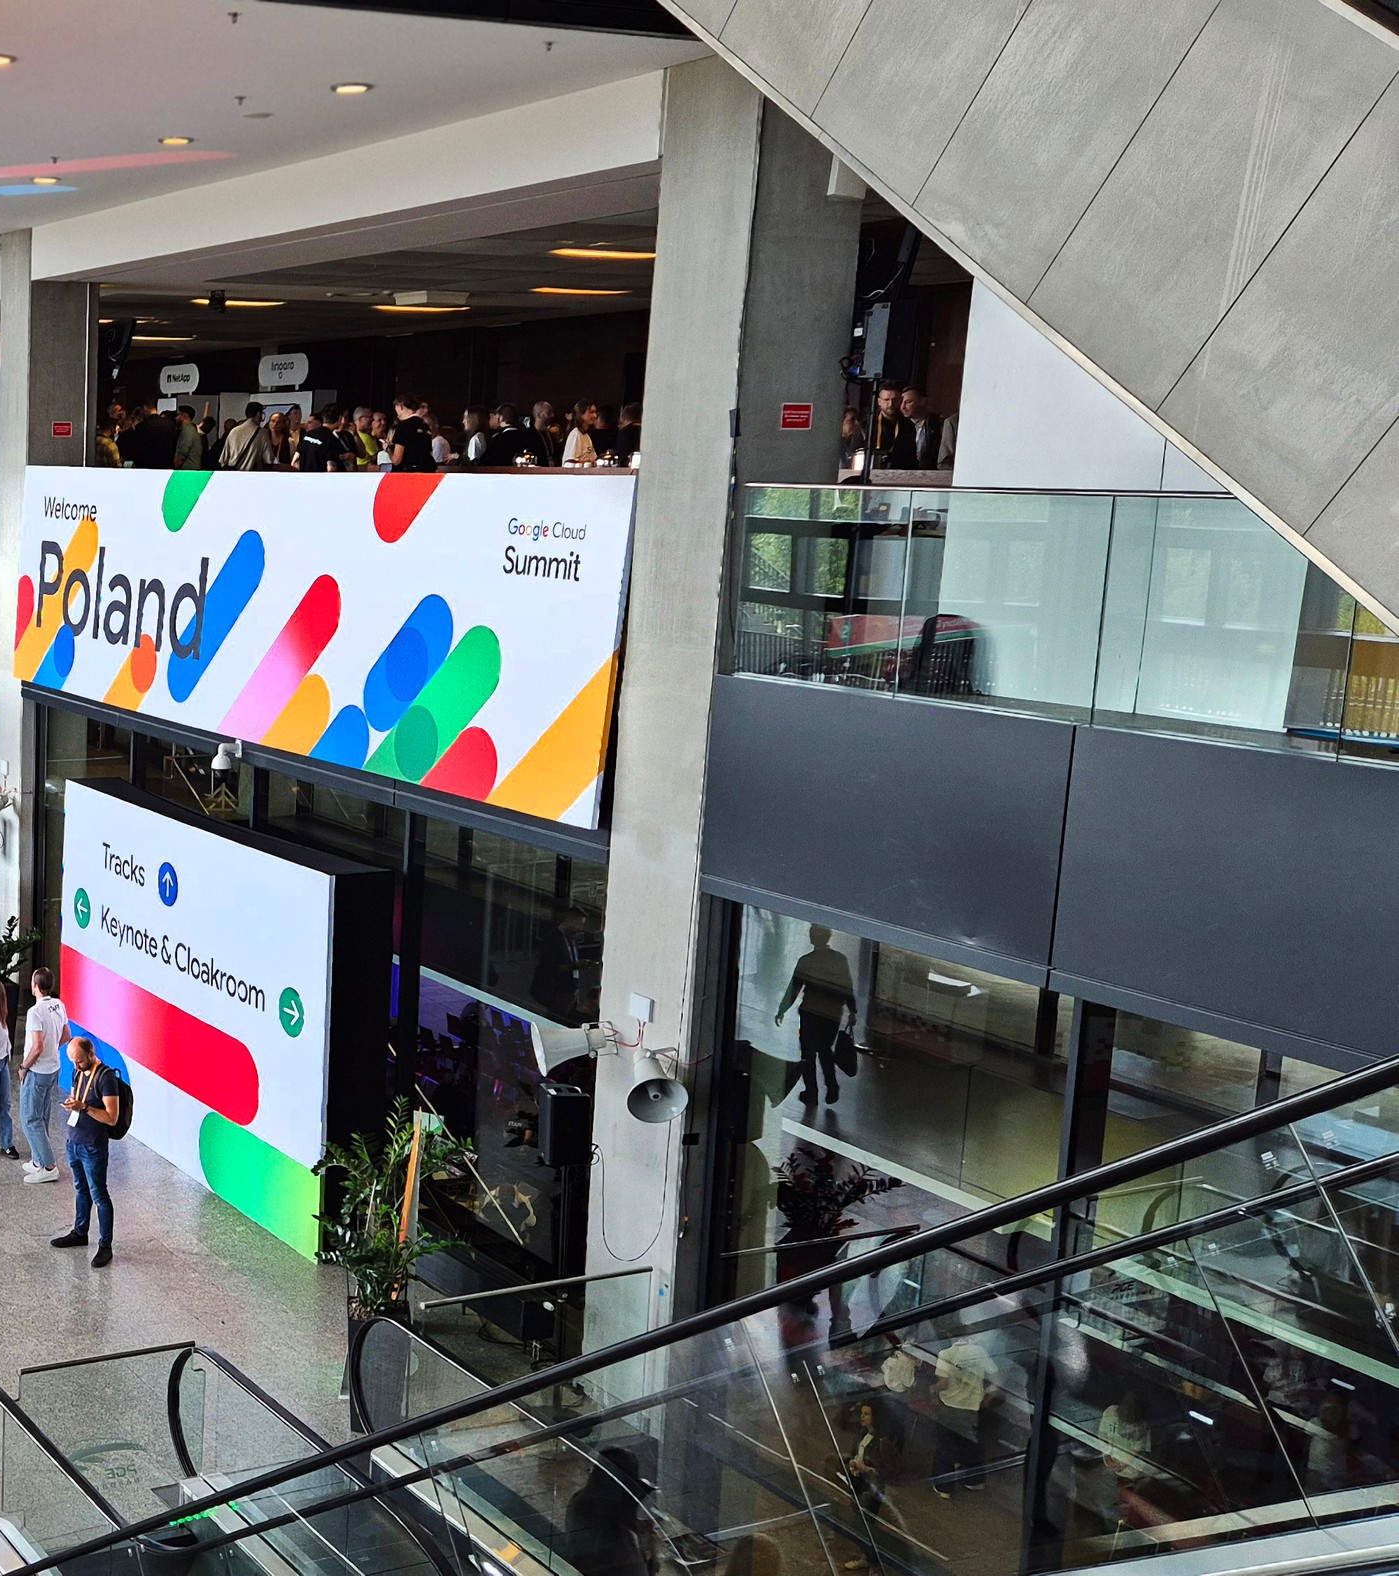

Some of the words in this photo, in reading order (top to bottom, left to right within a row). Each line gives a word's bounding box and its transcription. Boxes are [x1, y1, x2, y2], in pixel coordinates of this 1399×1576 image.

[172, 373, 191, 383] NetApp
[44, 495, 97, 522] Welcome
[508, 517, 550, 541] Google
[552, 521, 587, 541] Cloud
[502, 545, 581, 582] Summit
[36, 540, 210, 661] Poland
[102, 842, 146, 887] Tracks
[101, 904, 158, 958] Keynote
[161, 934, 172, 966] &
[175, 942, 266, 1012] Cloakroom
